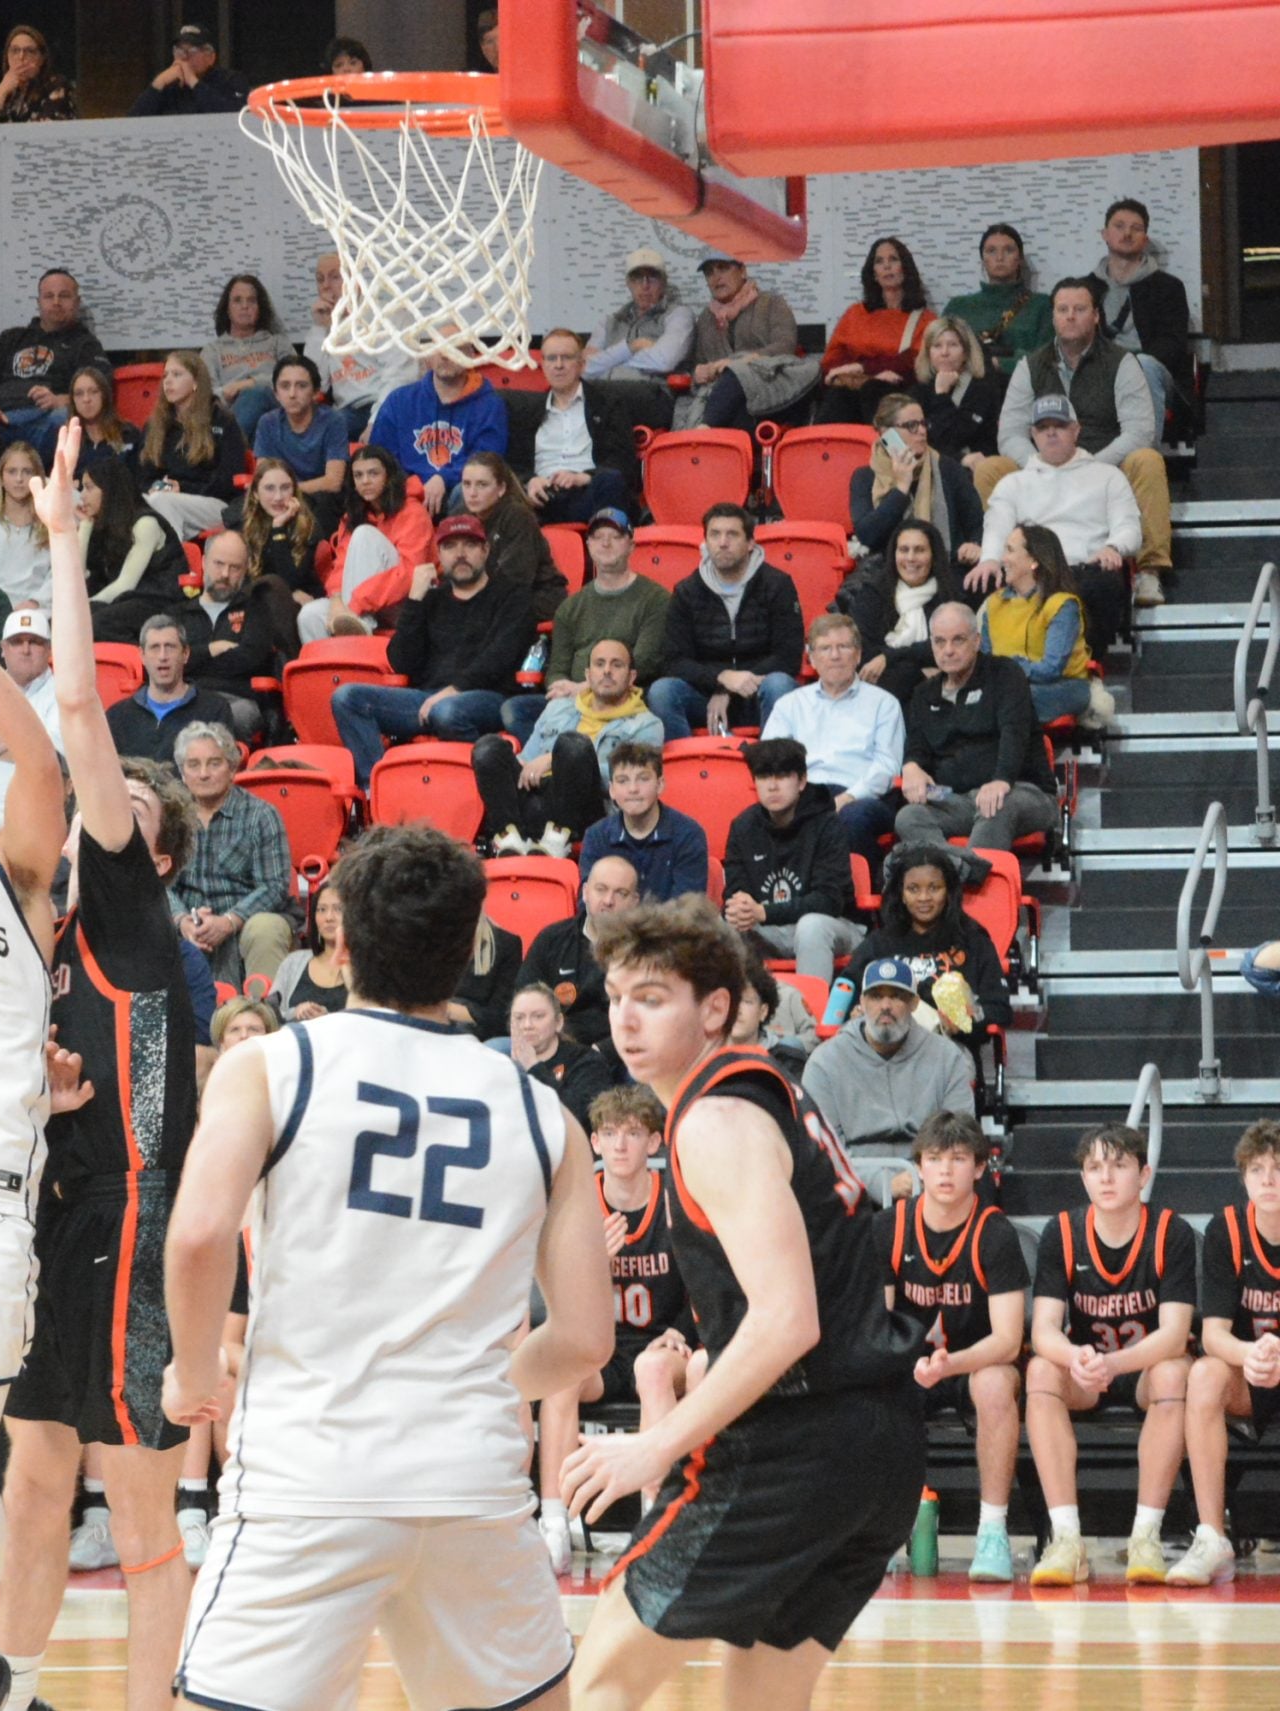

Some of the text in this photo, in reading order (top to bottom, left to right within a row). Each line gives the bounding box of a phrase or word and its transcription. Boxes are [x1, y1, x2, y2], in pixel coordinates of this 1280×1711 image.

[347, 1080, 491, 1229] 22
[611, 1252, 669, 1277] GEFIELD
[1074, 1288, 1157, 1317] RIDGEFIELD
